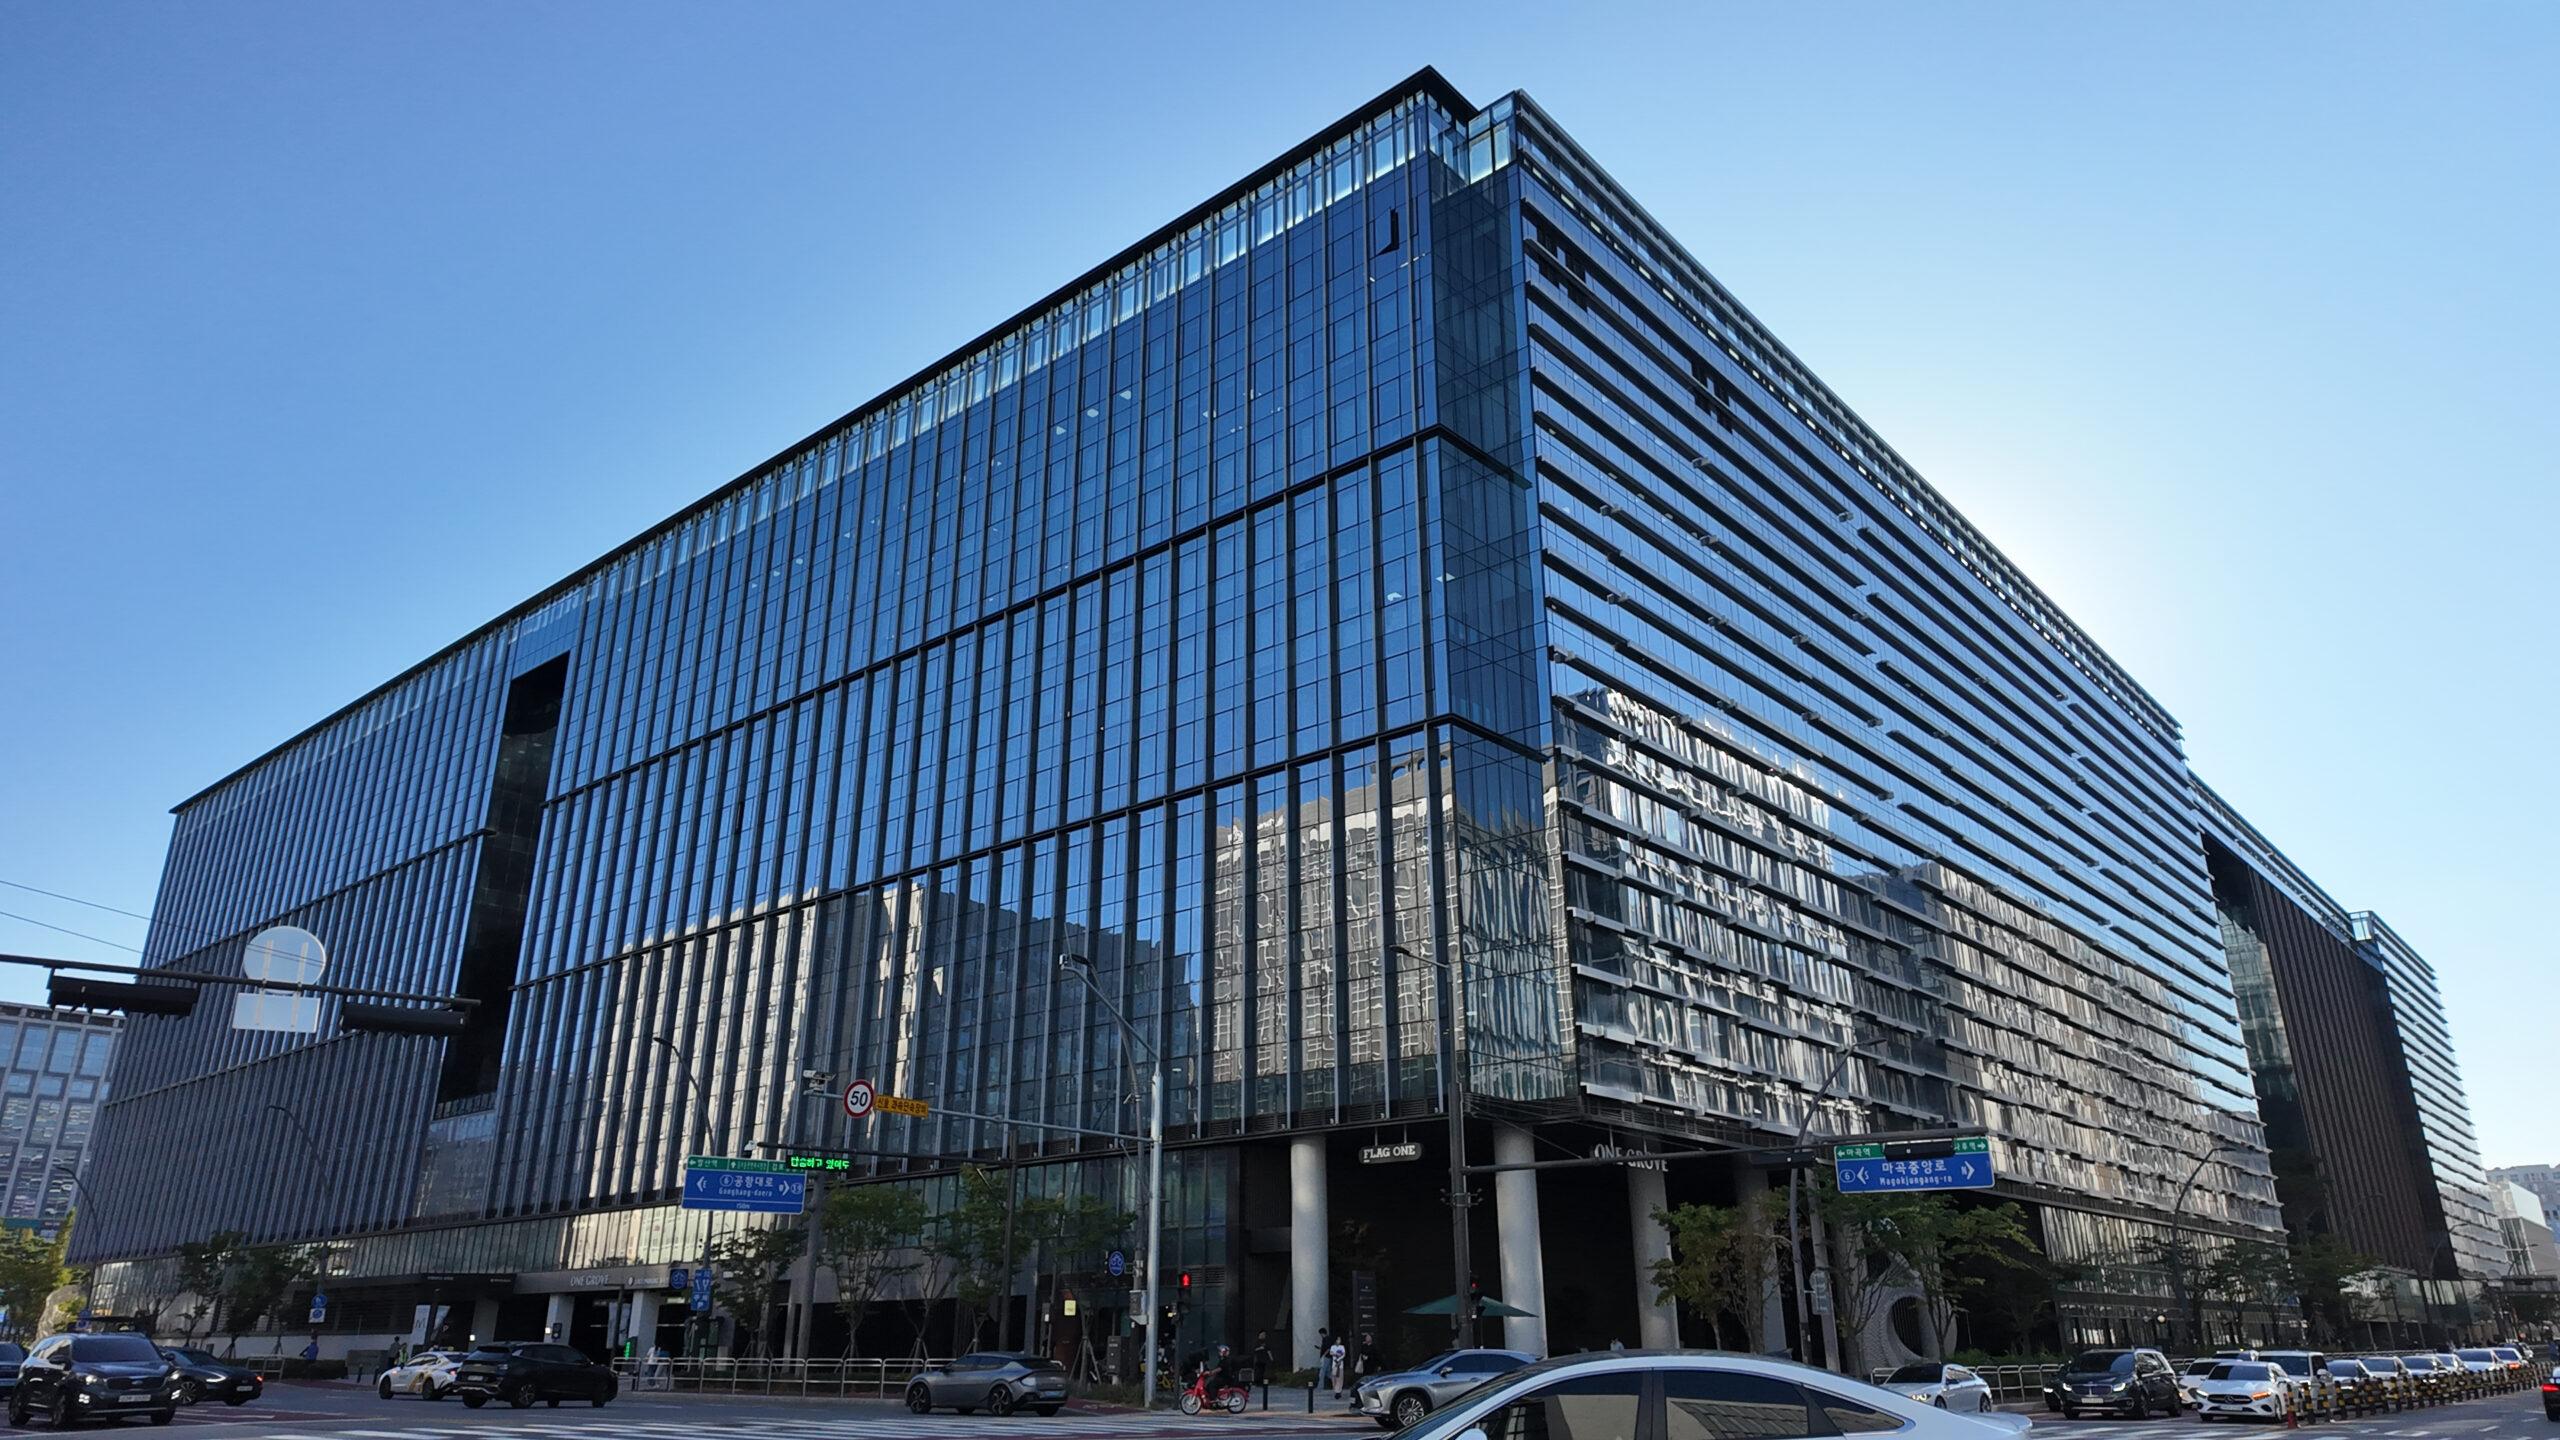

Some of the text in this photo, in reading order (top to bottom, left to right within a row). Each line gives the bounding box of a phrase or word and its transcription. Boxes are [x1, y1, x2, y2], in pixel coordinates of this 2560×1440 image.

[850, 1091, 868, 1107] 50
[1363, 1145, 1416, 1159] FLAG ONE
[1594, 1143, 1624, 1166] ONE
[1846, 1147, 1871, 1157] 마곡역
[1882, 1160, 1947, 1175] 마곡중앙로
[734, 1175, 774, 1188] 공항대로
[1879, 1175, 1953, 1187] Magokjungang-ro
[718, 1187, 773, 1197] Gonghang-daero
[570, 1275, 584, 1287] ONE
